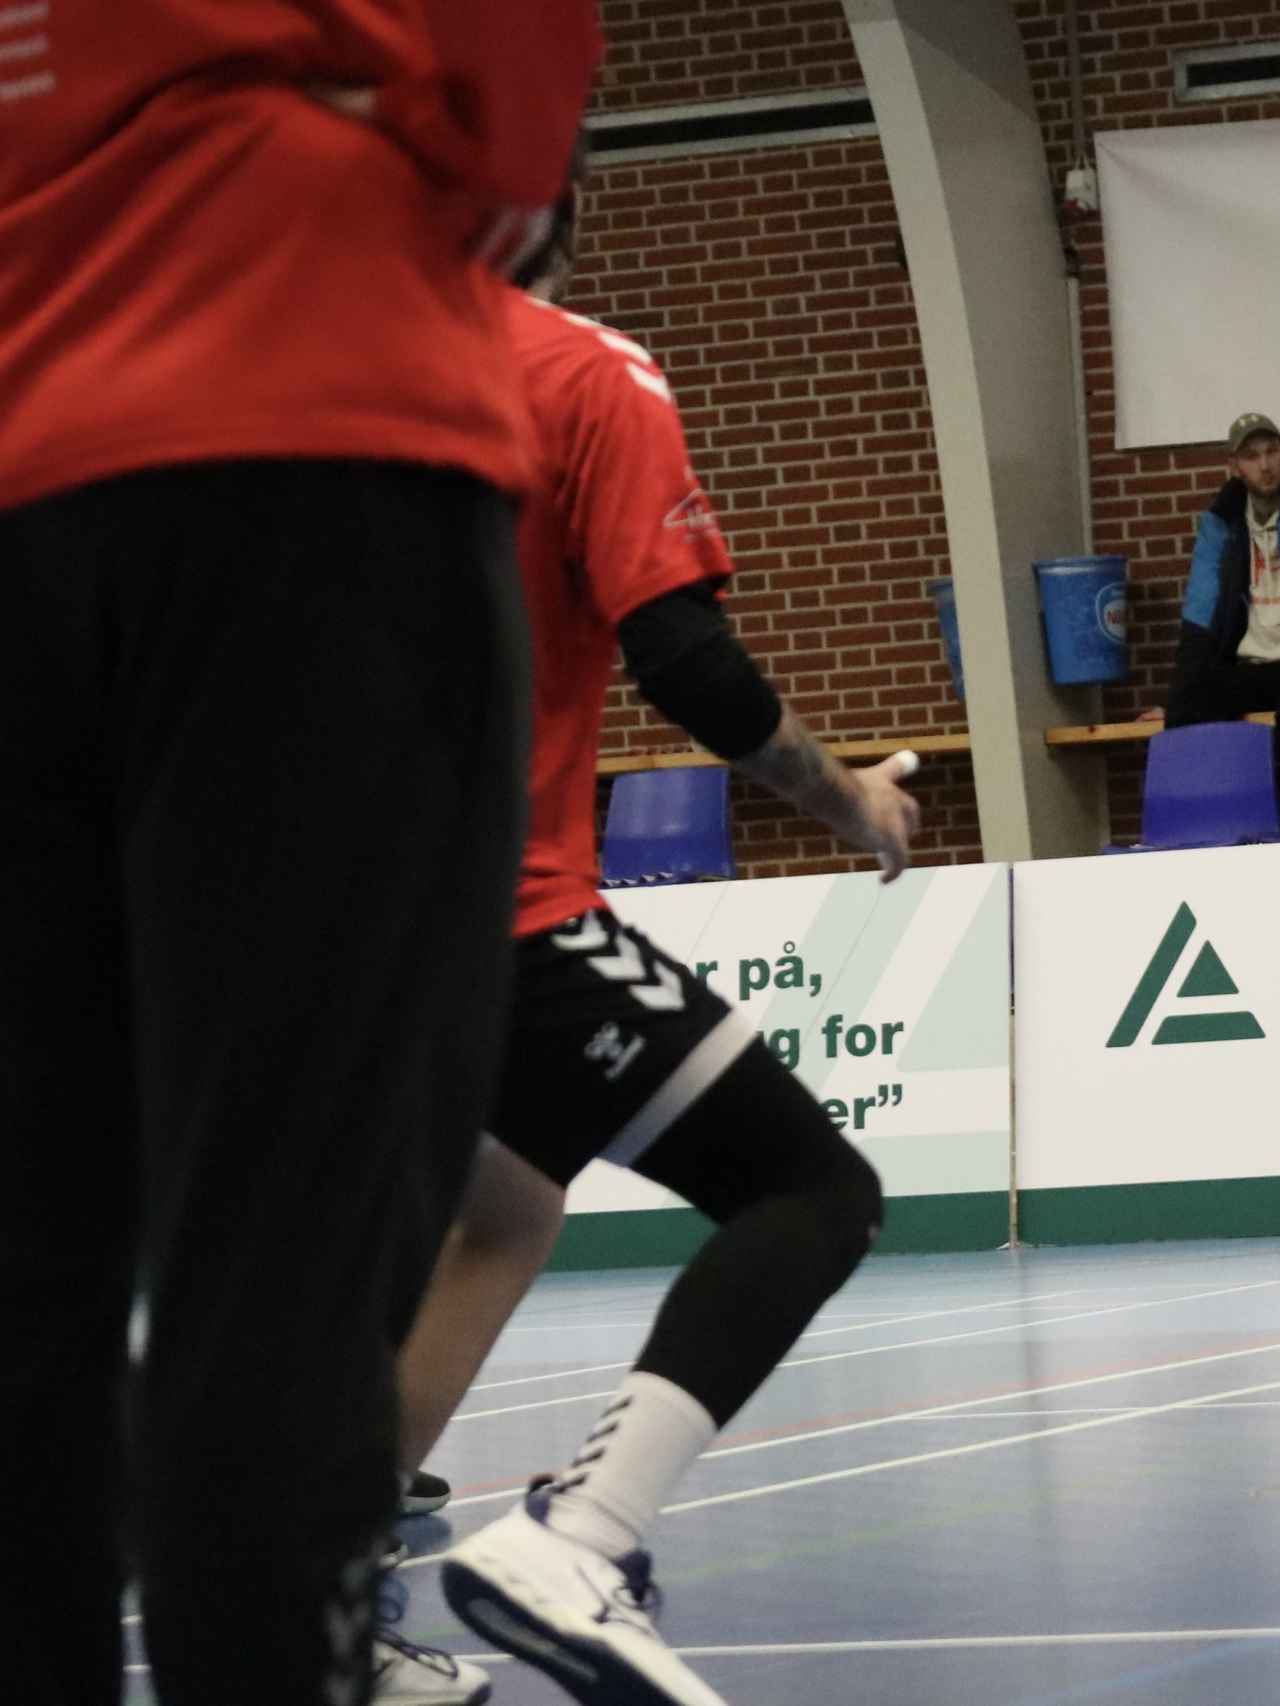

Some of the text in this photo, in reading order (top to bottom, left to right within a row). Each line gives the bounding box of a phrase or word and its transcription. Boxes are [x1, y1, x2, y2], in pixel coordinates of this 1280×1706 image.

[738, 940, 823, 1001] på,
[821, 1013, 905, 1059] for
[818, 1083, 903, 1131] er”
